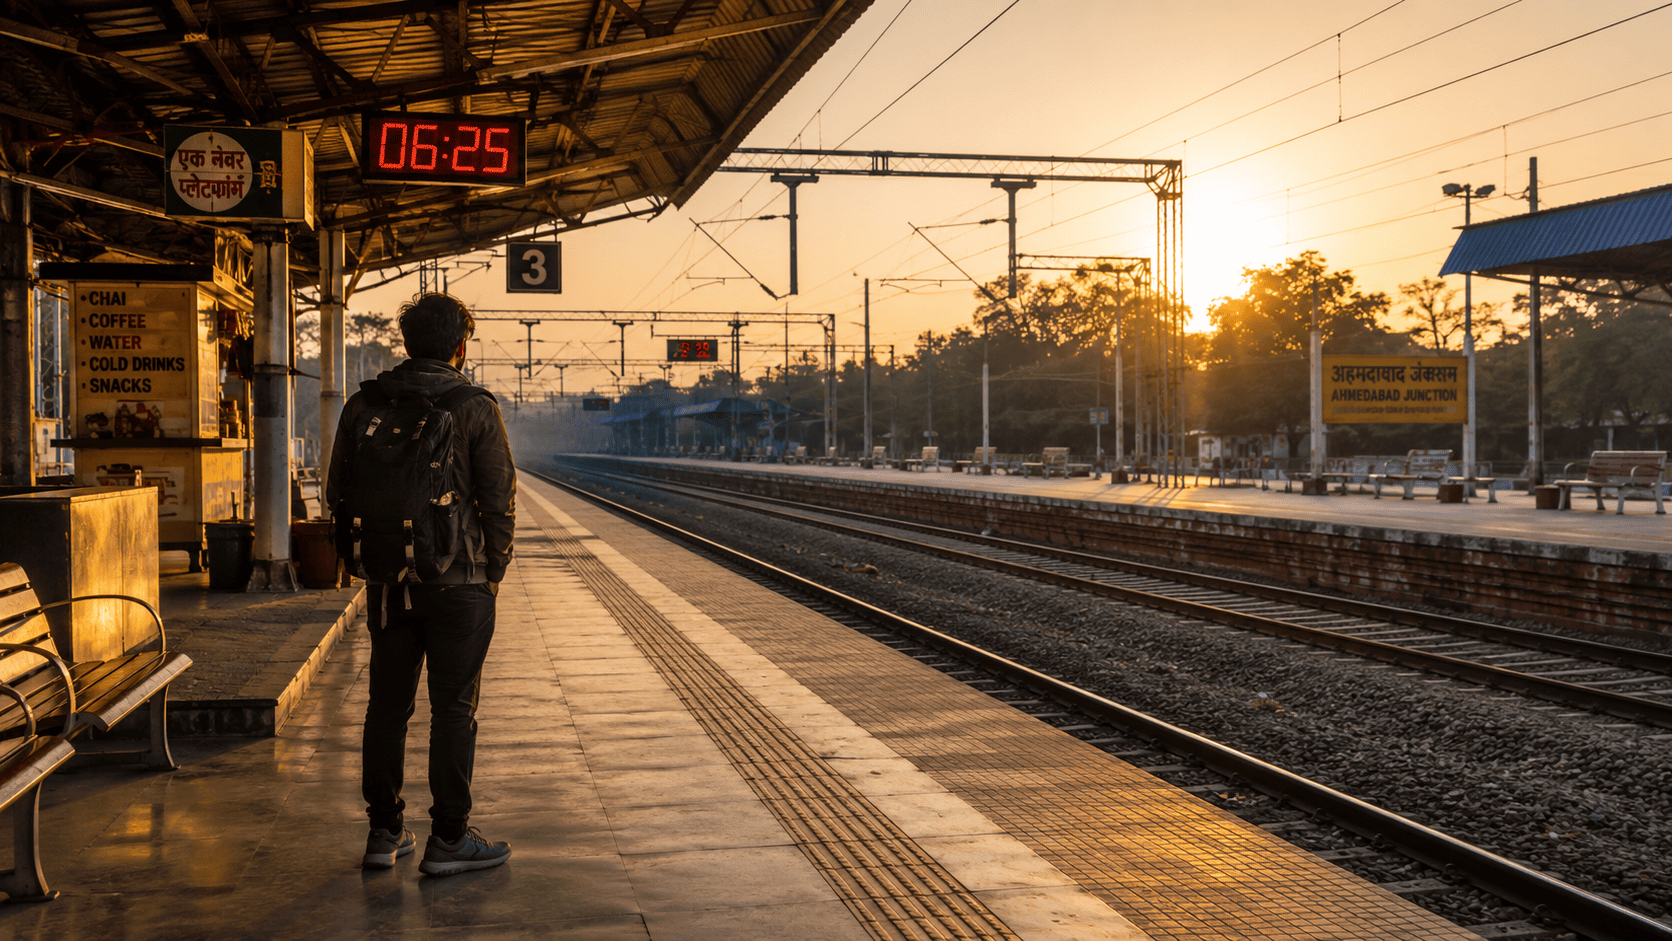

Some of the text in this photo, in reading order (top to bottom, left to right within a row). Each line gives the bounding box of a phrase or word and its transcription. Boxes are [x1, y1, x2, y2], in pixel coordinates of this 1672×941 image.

[379, 122, 510, 173] 06:25
[178, 149, 206, 170] एक
[521, 249, 547, 285] 3
[89, 291, 126, 306] CHAI
[89, 313, 146, 328] COFFEE
[89, 335, 142, 350] WATER
[89, 357, 185, 372] COLD DRINKS
[89, 378, 152, 393] SNACKS
[1331, 389, 1458, 402] AHMEDABAD JUNCTION
